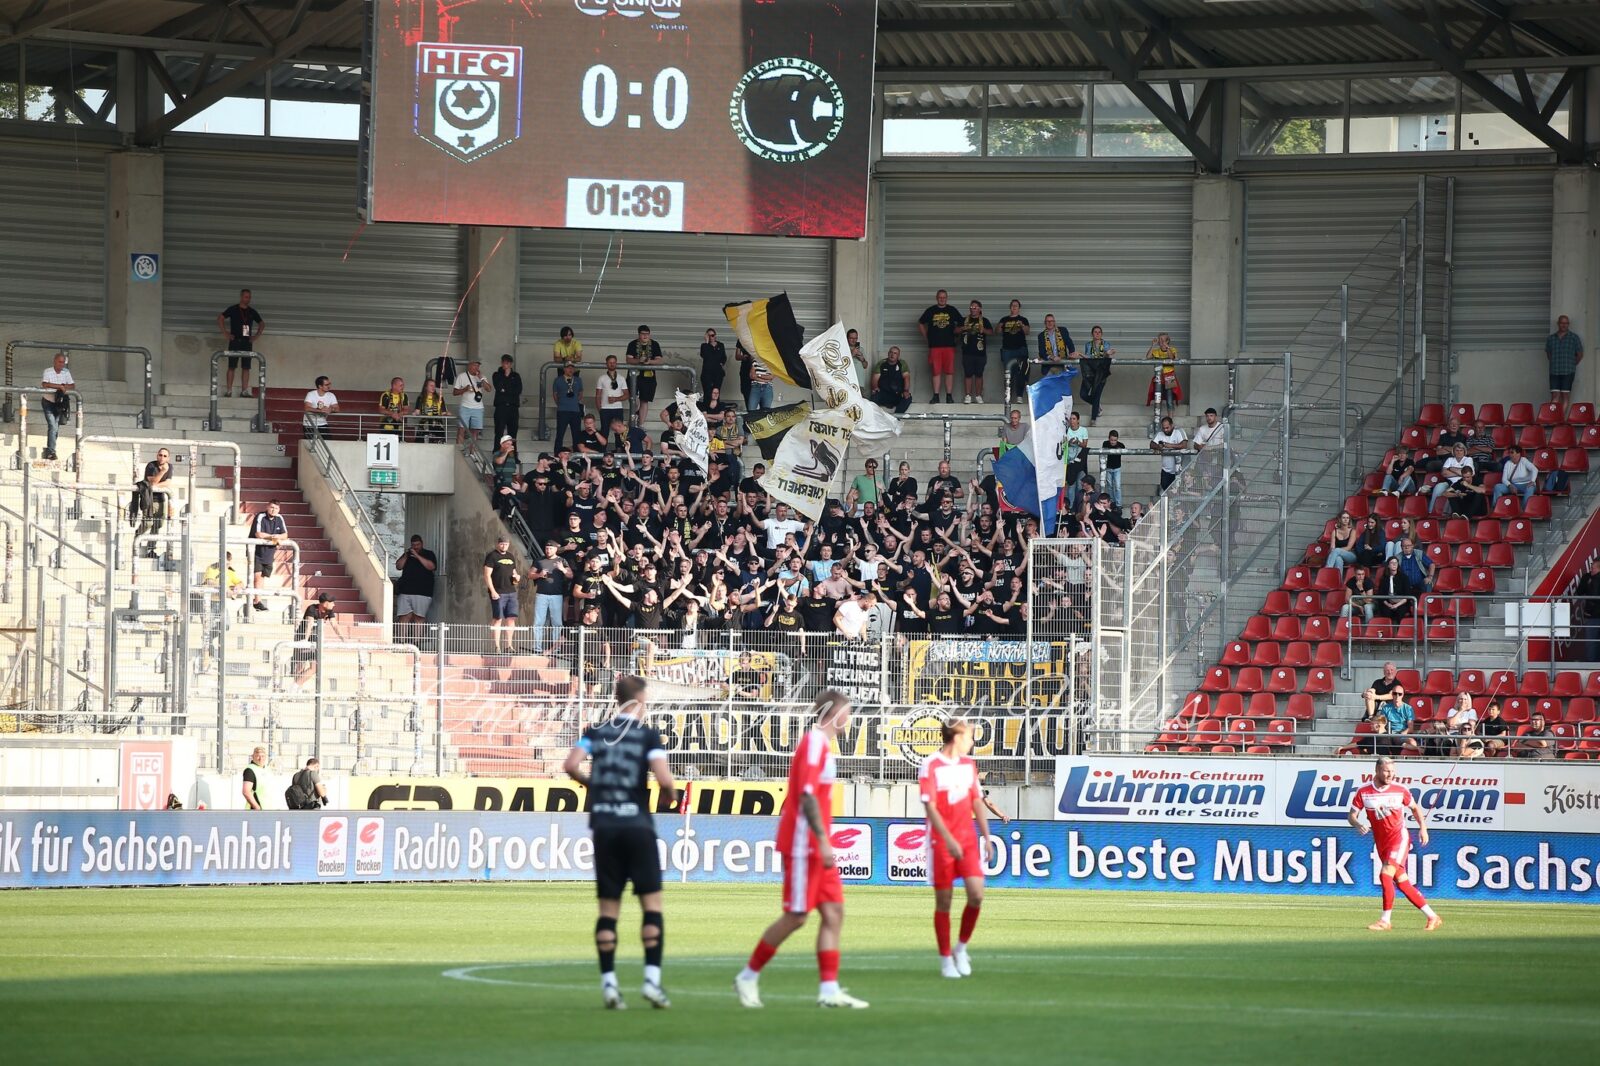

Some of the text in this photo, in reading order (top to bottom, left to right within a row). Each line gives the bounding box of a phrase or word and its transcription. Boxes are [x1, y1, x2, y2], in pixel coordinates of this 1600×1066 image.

[428, 51, 509, 76] HFC
[582, 64, 689, 129] 0:0
[586, 182, 671, 218] 01:39
[374, 442, 391, 460] 11
[834, 650, 879, 667] ULTRAS
[648, 711, 898, 758] BADKUVE
[895, 729, 944, 743] BADKUR
[135, 759, 160, 773] HFC
[1132, 769, 1264, 781] Wohn-Centrum
[1058, 766, 1266, 815] Lührmann
[1165, 808, 1195, 817] der
[1200, 808, 1260, 818] Saline
[1432, 813, 1494, 825] Saline
[32, 821, 73, 873] für
[81, 817, 292, 873] Sachsen-Anhalt
[394, 822, 460, 870] Radio
[468, 823, 596, 870] Brocke
[319, 861, 345, 873] Brocken
[356, 860, 381, 872] Brocken
[979, 830, 1051, 877] Die
[1068, 830, 1196, 880] beste
[1213, 836, 1355, 884] Musik
[1456, 842, 1600, 892] Sachs
[837, 865, 869, 876] ocken
